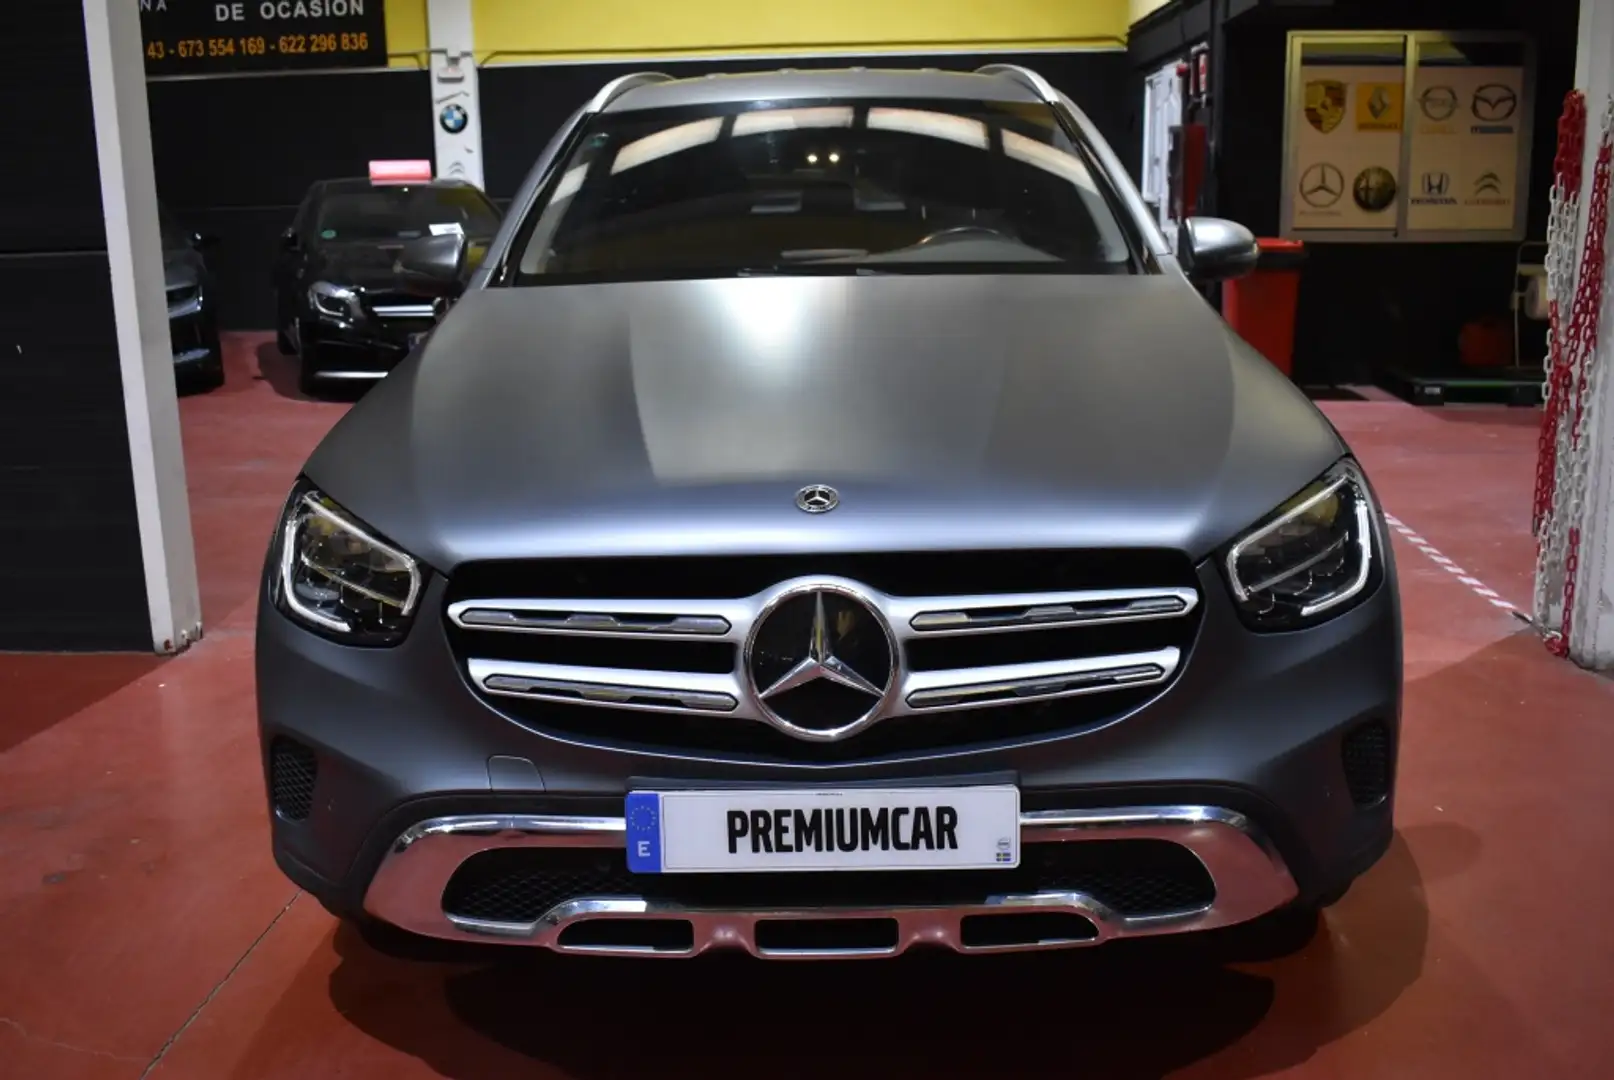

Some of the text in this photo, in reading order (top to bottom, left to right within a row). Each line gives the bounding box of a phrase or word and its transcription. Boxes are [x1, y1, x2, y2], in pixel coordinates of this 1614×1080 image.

[215, 4, 246, 22] DE
[177, 39, 205, 57] 673
[208, 37, 236, 56] 554
[239, 36, 265, 55] 169
[279, 34, 306, 53] 622
[309, 33, 337, 52] 296
[340, 32, 368, 50] 836
[726, 806, 958, 854] PREMIUMCAR
[637, 841, 650, 857] E
